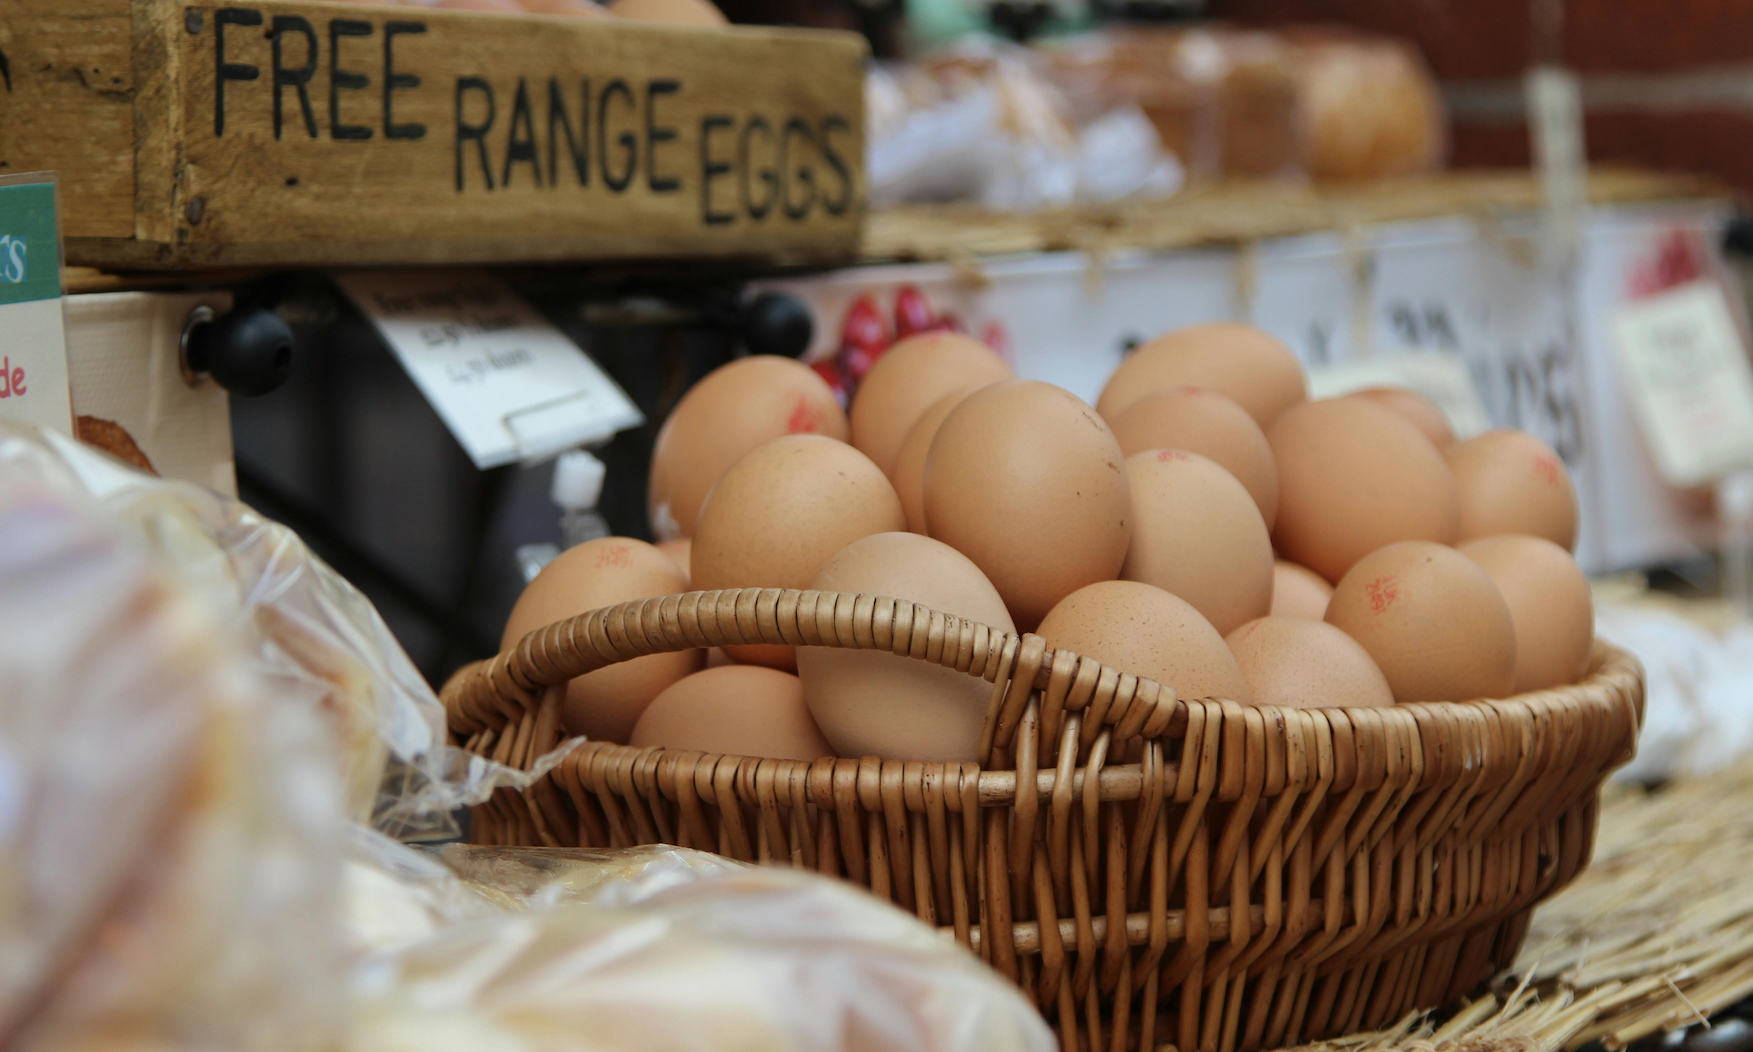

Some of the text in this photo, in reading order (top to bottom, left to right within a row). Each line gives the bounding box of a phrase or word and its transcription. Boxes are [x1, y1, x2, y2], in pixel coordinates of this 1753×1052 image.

[214, 7, 854, 226] FREE RANGE EGGS
